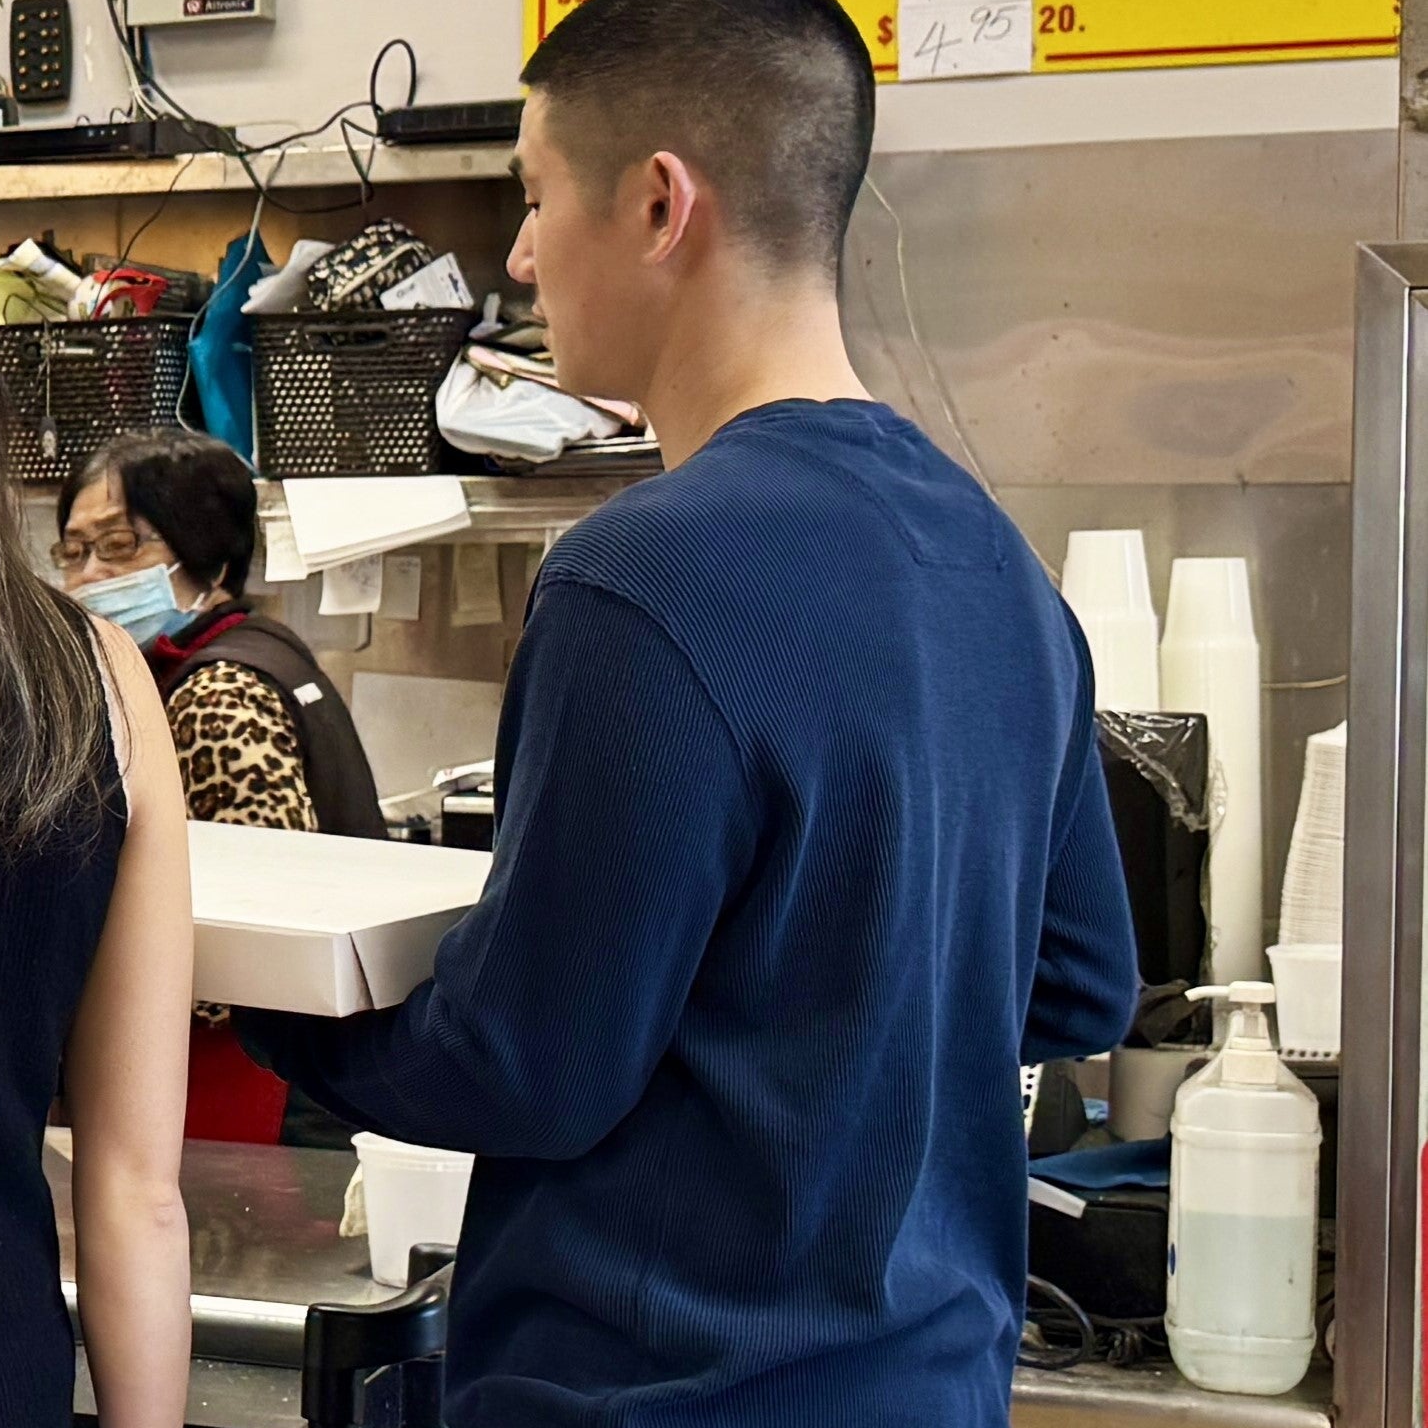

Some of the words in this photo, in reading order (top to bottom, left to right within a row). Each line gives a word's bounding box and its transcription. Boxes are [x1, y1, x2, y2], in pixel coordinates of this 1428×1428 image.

[877, 15, 894, 45] $
[1039, 5, 1086, 34] 20.
[915, 5, 1018, 72] 4.95
